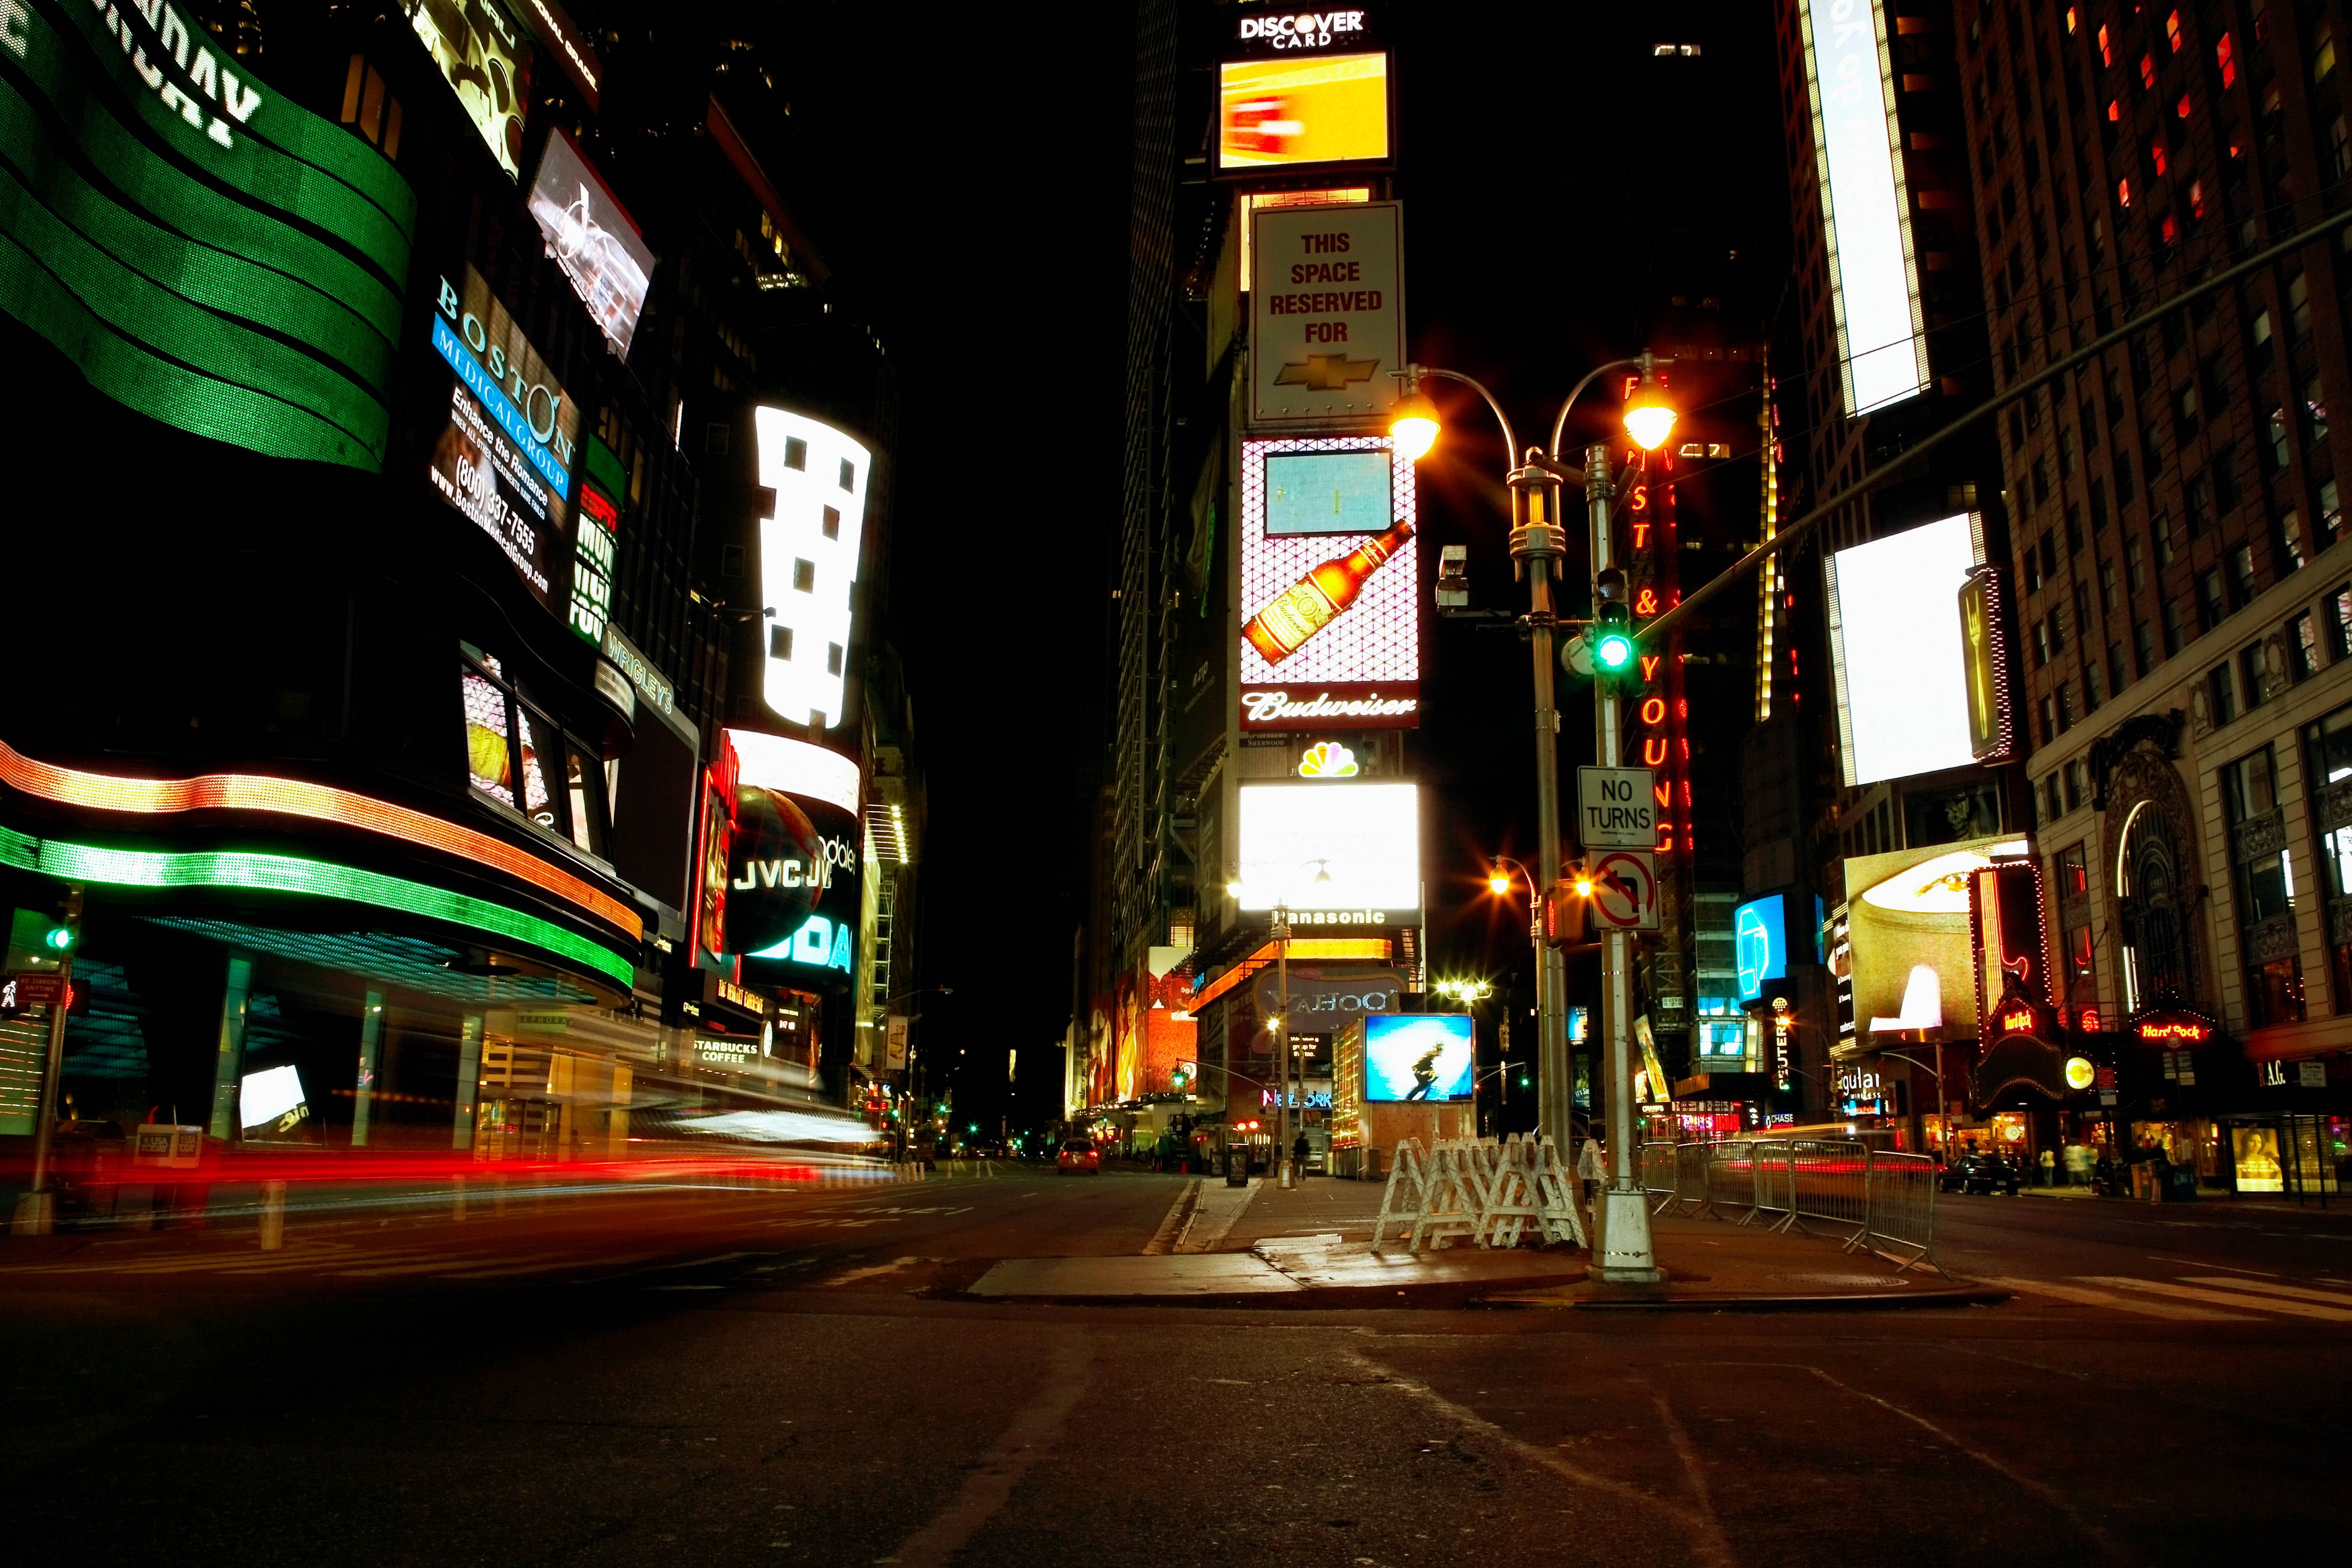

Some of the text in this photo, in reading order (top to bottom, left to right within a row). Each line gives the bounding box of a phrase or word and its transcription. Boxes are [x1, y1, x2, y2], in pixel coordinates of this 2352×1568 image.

[1240, 11, 1364, 39] DISCOVER
[1273, 31, 1331, 50] CARD
[1301, 233, 1350, 254] THIS
[1291, 262, 1359, 284] SPACE
[1270, 291, 1382, 315] RESERVED
[1305, 322, 1347, 343] FOR
[437, 274, 575, 465] BOSTON
[440, 329, 563, 486] MEDICAL GROUP
[452, 386, 548, 506] Enhance the Romance
[452, 408, 467, 432] WHEN
[466, 427, 476, 444] ALL
[492, 455, 520, 493] TREATMENTS
[520, 487, 532, 505] HAVE
[531, 499, 546, 520] FAILED
[456, 454, 536, 555] (800) 337-7555
[431, 466, 548, 594] www.BostonMedicalGroup.com
[1277, 596, 1309, 637] Budweiser
[607, 630, 673, 715] WRIGLEY'S
[1241, 691, 1417, 721] Budweiser
[1601, 779, 1632, 802] NO
[1587, 806, 1651, 829] TURNS
[734, 859, 801, 890] JVC
[2142, 1025, 2172, 1037] Hard
[694, 1040, 758, 1054] STARBUCKS
[702, 1051, 745, 1064] COFFEE
[1771, 1113, 1794, 1123] CHASE
[141, 1144, 168, 1153] TODAY
